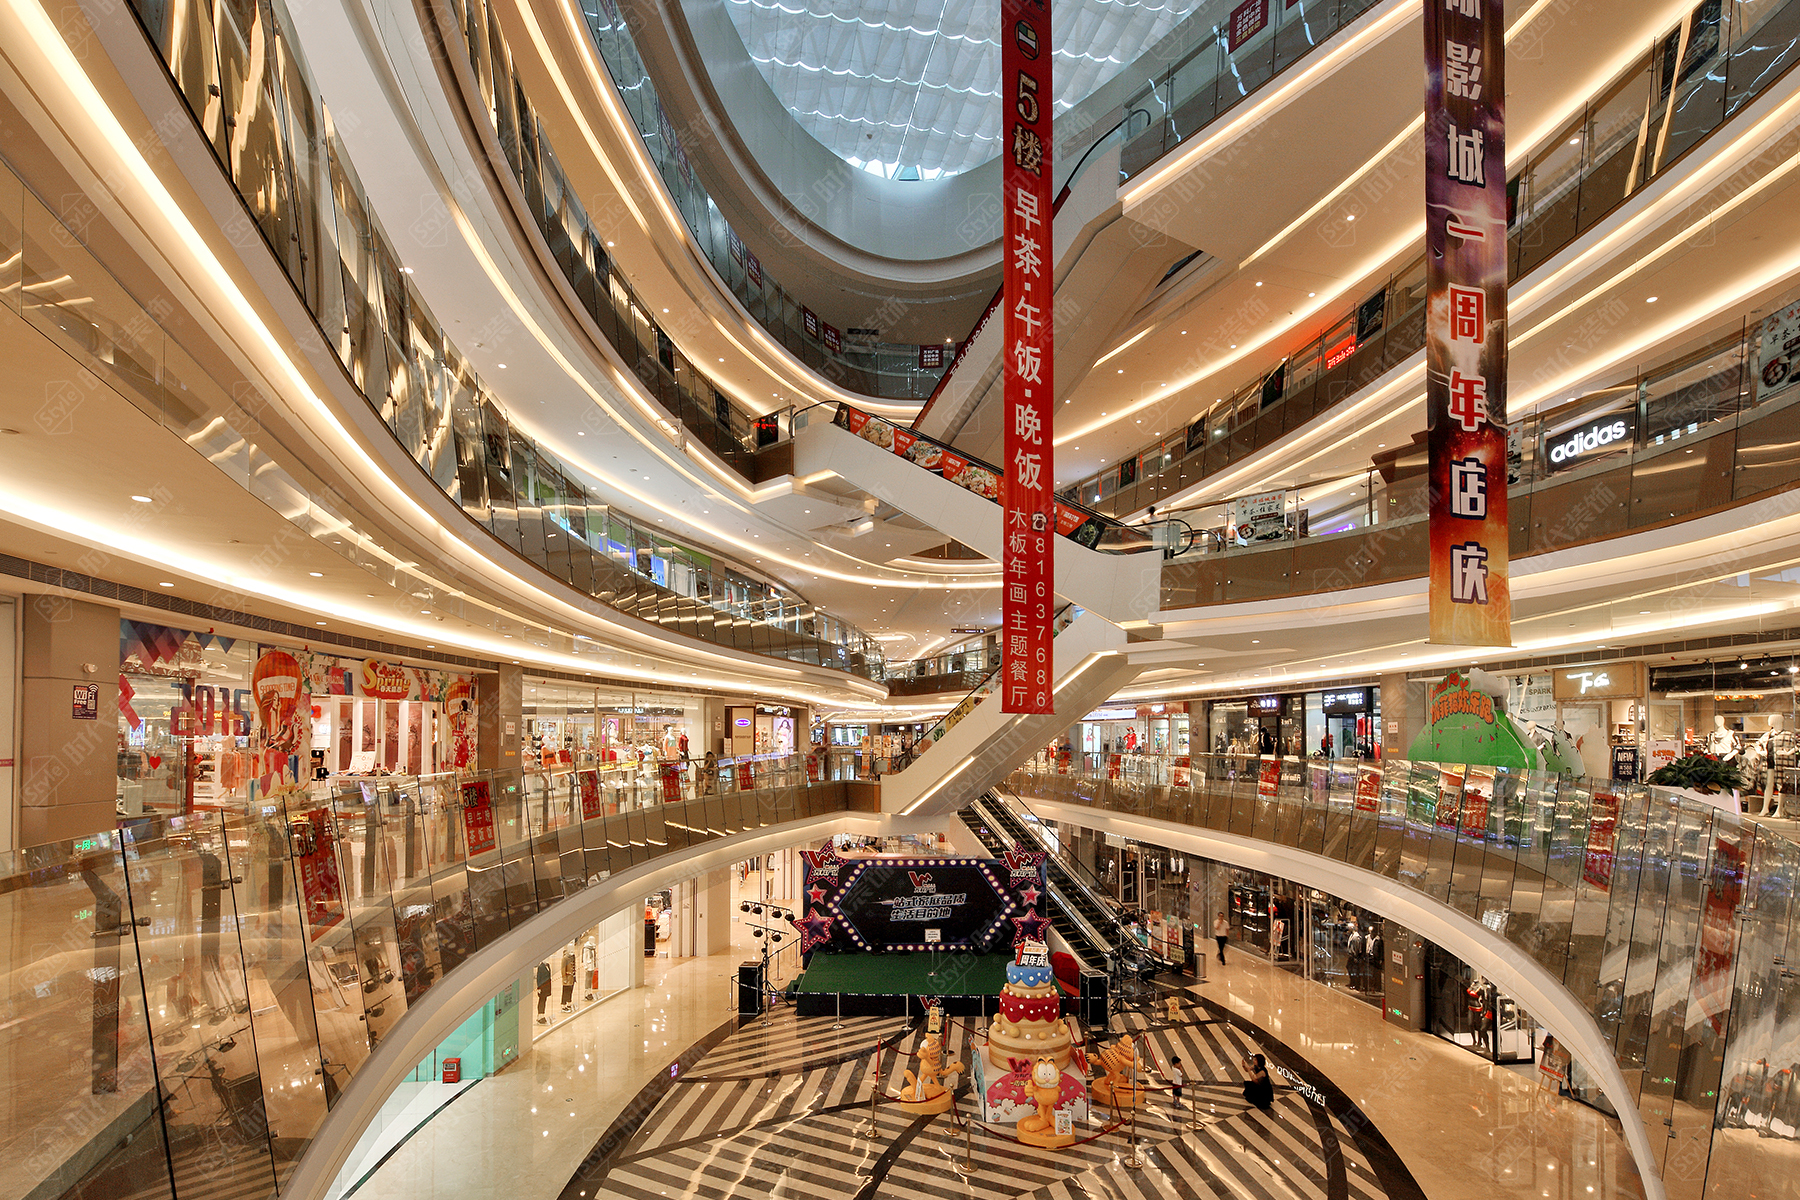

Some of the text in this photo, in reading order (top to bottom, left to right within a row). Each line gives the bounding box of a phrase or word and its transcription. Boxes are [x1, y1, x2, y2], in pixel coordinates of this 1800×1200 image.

[1550, 421, 1626, 463] adidas
[1009, 507, 1028, 707] 木板年画主题餐厅
[1036, 537, 1046, 707] 81637686
[170, 683, 251, 736] 2015
[1617, 752, 1634, 761] NEW
[890, 907, 951, 921] 生活目的地
